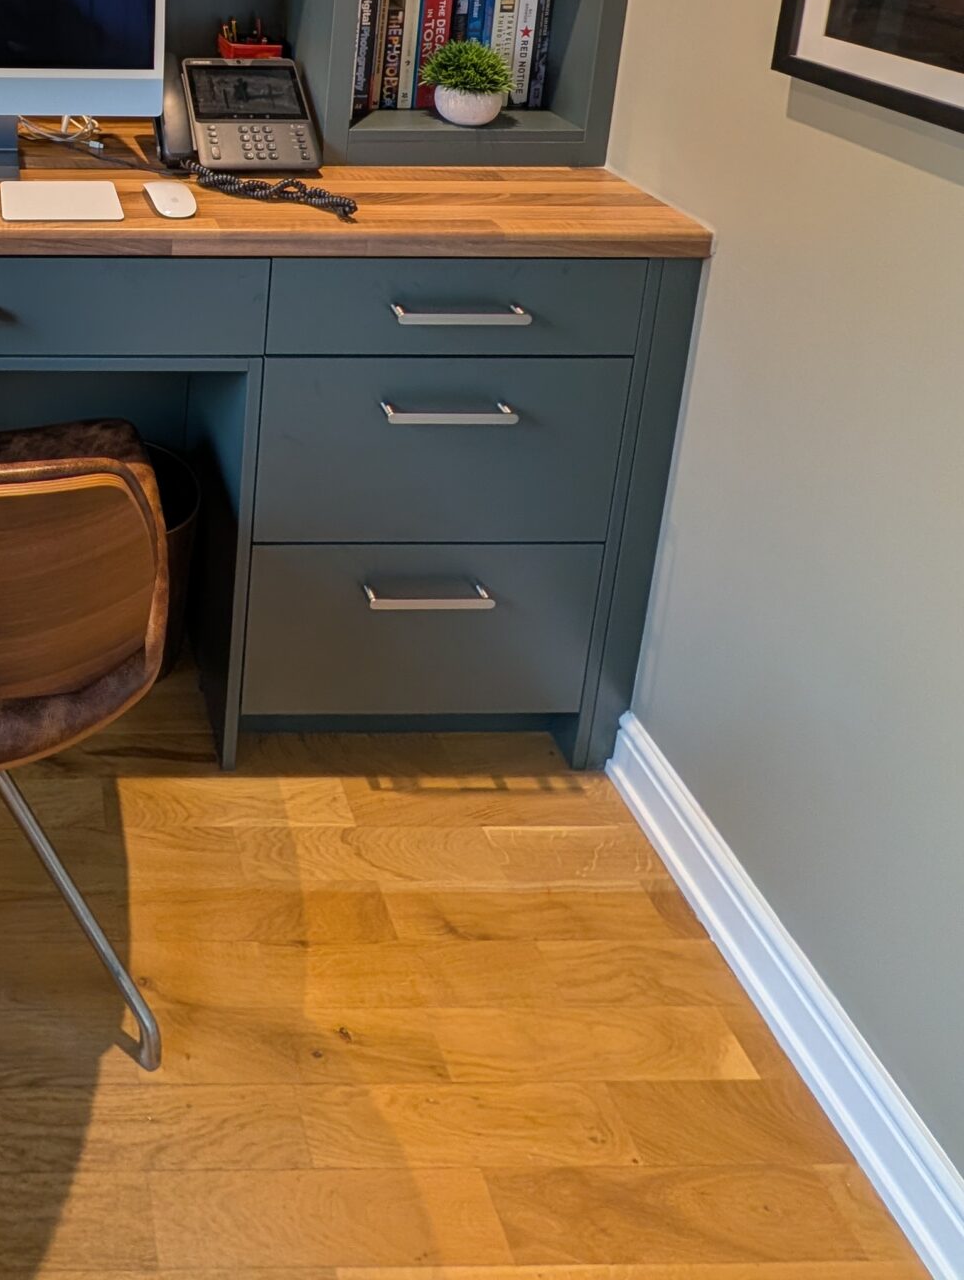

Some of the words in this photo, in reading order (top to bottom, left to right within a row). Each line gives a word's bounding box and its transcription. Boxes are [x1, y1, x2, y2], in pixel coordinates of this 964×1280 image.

[426, 8, 434, 18] IN
[438, 0, 446, 16] THE
[422, 18, 434, 58] TORY
[520, 40, 528, 58] RED
[356, 26, 371, 91] Photography
[516, 61, 526, 94] NOTICE
